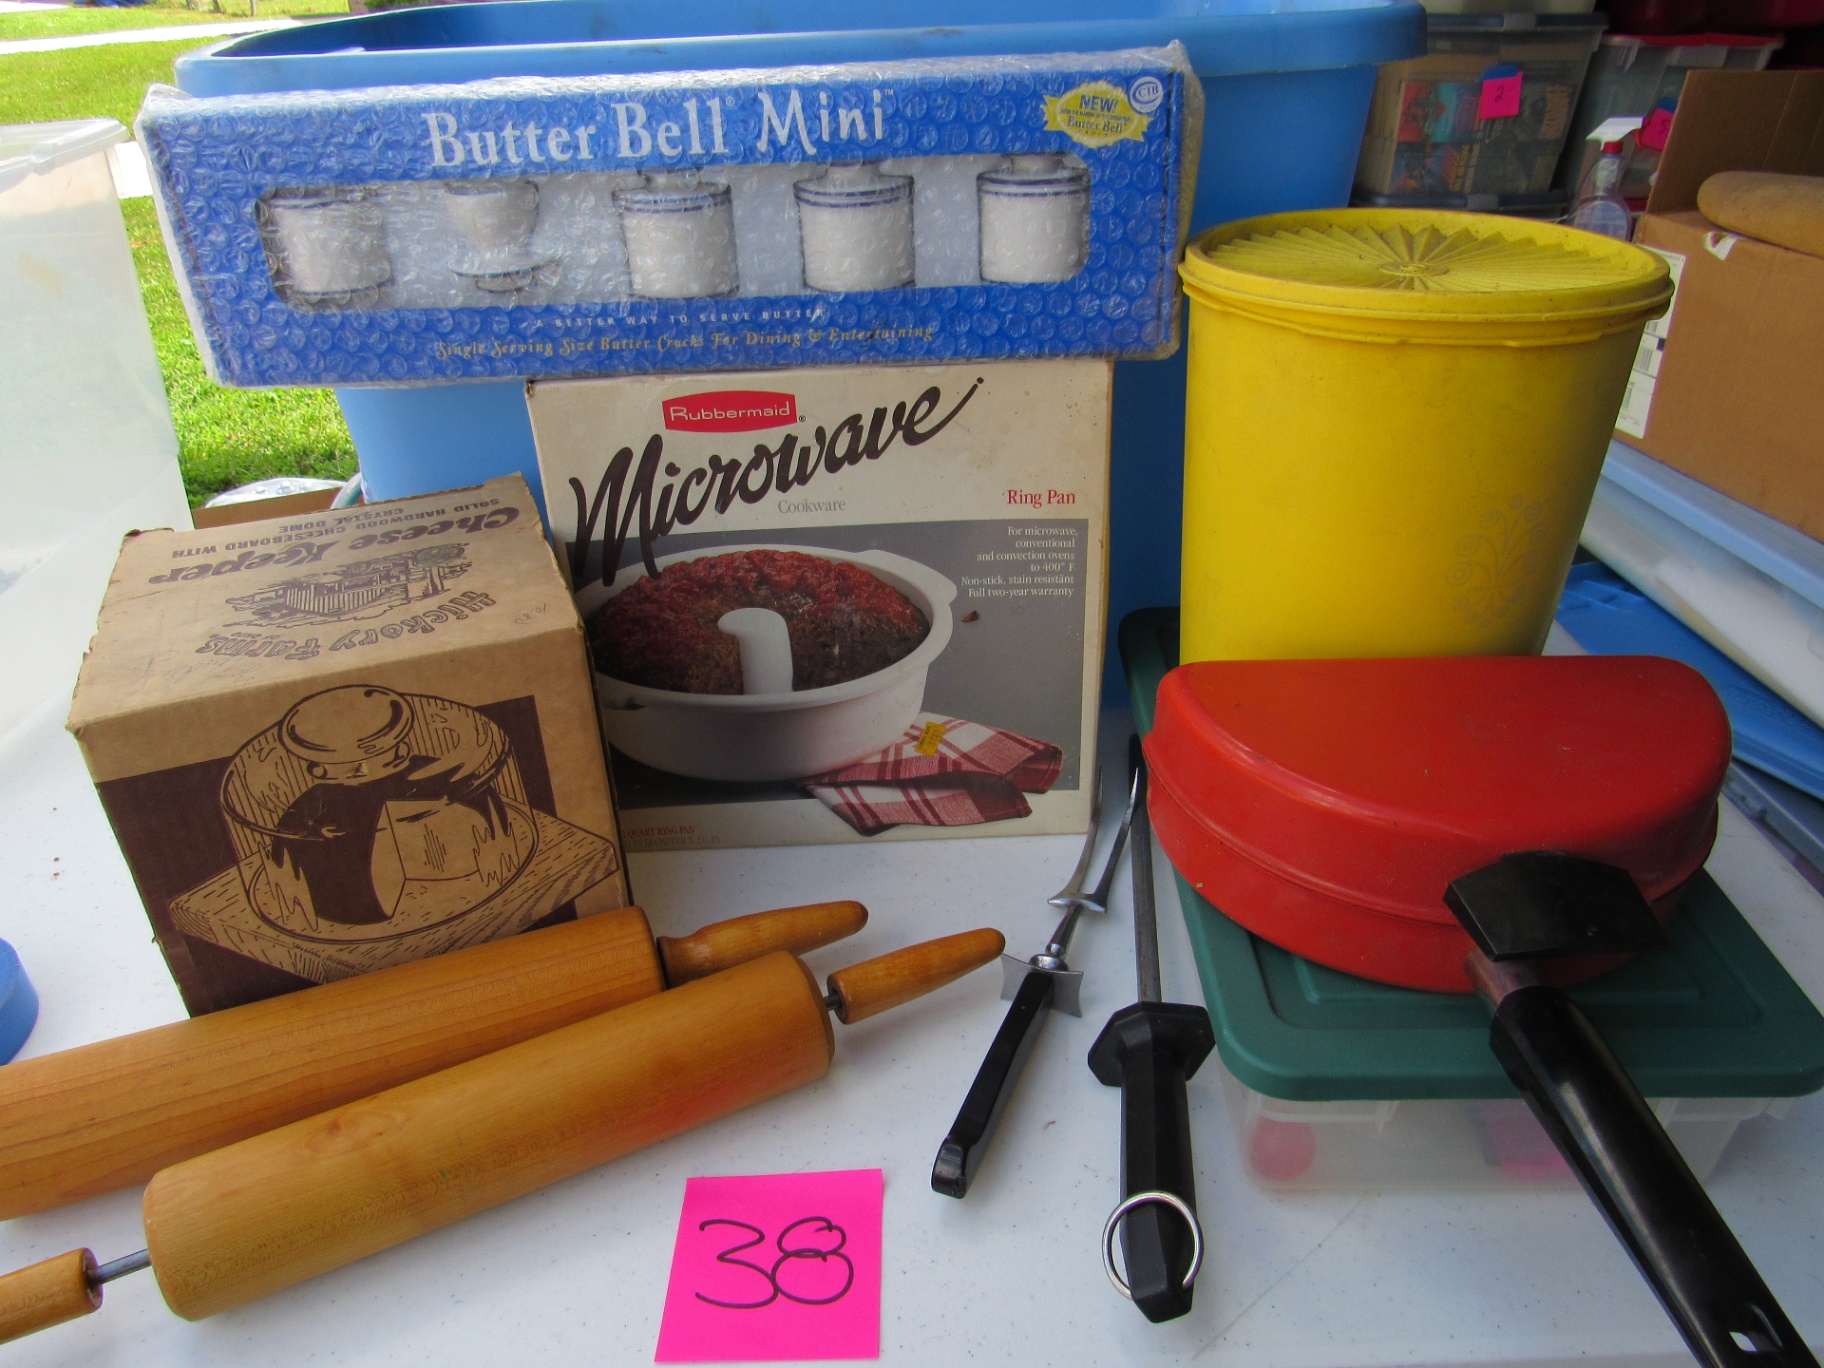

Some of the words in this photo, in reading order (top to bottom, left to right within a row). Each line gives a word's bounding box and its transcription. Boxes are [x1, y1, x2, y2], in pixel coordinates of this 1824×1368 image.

[1079, 93, 1119, 113] NEW!
[1494, 85, 1504, 103] 2
[421, 112, 597, 167] Butter
[610, 97, 729, 158] Bell
[757, 89, 885, 155] Mini
[1067, 115, 1100, 131] Butter
[1102, 119, 1124, 134] Bell
[555, 316, 615, 328] BETTER
[626, 314, 658, 325] WAY
[669, 314, 688, 324] TO
[700, 312, 751, 323] SERVE
[762, 308, 824, 320] BUTTER
[436, 341, 485, 360] Single
[490, 339, 554, 358] Serving
[559, 337, 594, 356] Size
[601, 336, 650, 350] Butter
[657, 332, 705, 352] Crocks
[711, 332, 739, 346] For
[746, 331, 801, 349] Dining
[808, 328, 823, 343] &
[829, 325, 934, 342] Entertaining
[669, 401, 791, 422] Rubbermaid
[569, 376, 985, 588] Microwave
[453, 498, 500, 513] SOLID
[777, 499, 847, 515] Cookware
[1007, 489, 1043, 509] Ring
[1046, 489, 1077, 505] Pan
[278, 519, 327, 534] DOME
[331, 507, 405, 527] CRYSTAL
[355, 508, 447, 530] HARDWOOD
[225, 526, 348, 551] CHEESEBOARD
[348, 506, 520, 551] Cheese
[1008, 526, 1022, 536] For
[1024, 526, 1078, 537] microwave,
[171, 545, 218, 559] WITH
[1015, 537, 1075, 549] conventional
[148, 539, 342, 585] Keeper
[976, 551, 994, 562] and
[996, 550, 1046, 561] convection
[1048, 551, 1075, 560] ovens
[1030, 562, 1040, 572] to
[1042, 561, 1066, 572] 400°
[1068, 562, 1076, 572] F
[961, 575, 1006, 586] Non-stick,
[1008, 574, 1032, 585] stain
[1034, 574, 1074, 585] resistant
[968, 587, 986, 598] Full
[987, 587, 1029, 599] two-year
[1030, 587, 1074, 598] warranty
[329, 590, 498, 652] Hickory
[194, 635, 322, 661] Farms
[627, 827, 655, 838] QUART
[657, 825, 678, 836] RING
[679, 824, 695, 835] PAN
[694, 1214, 855, 1309] 38
